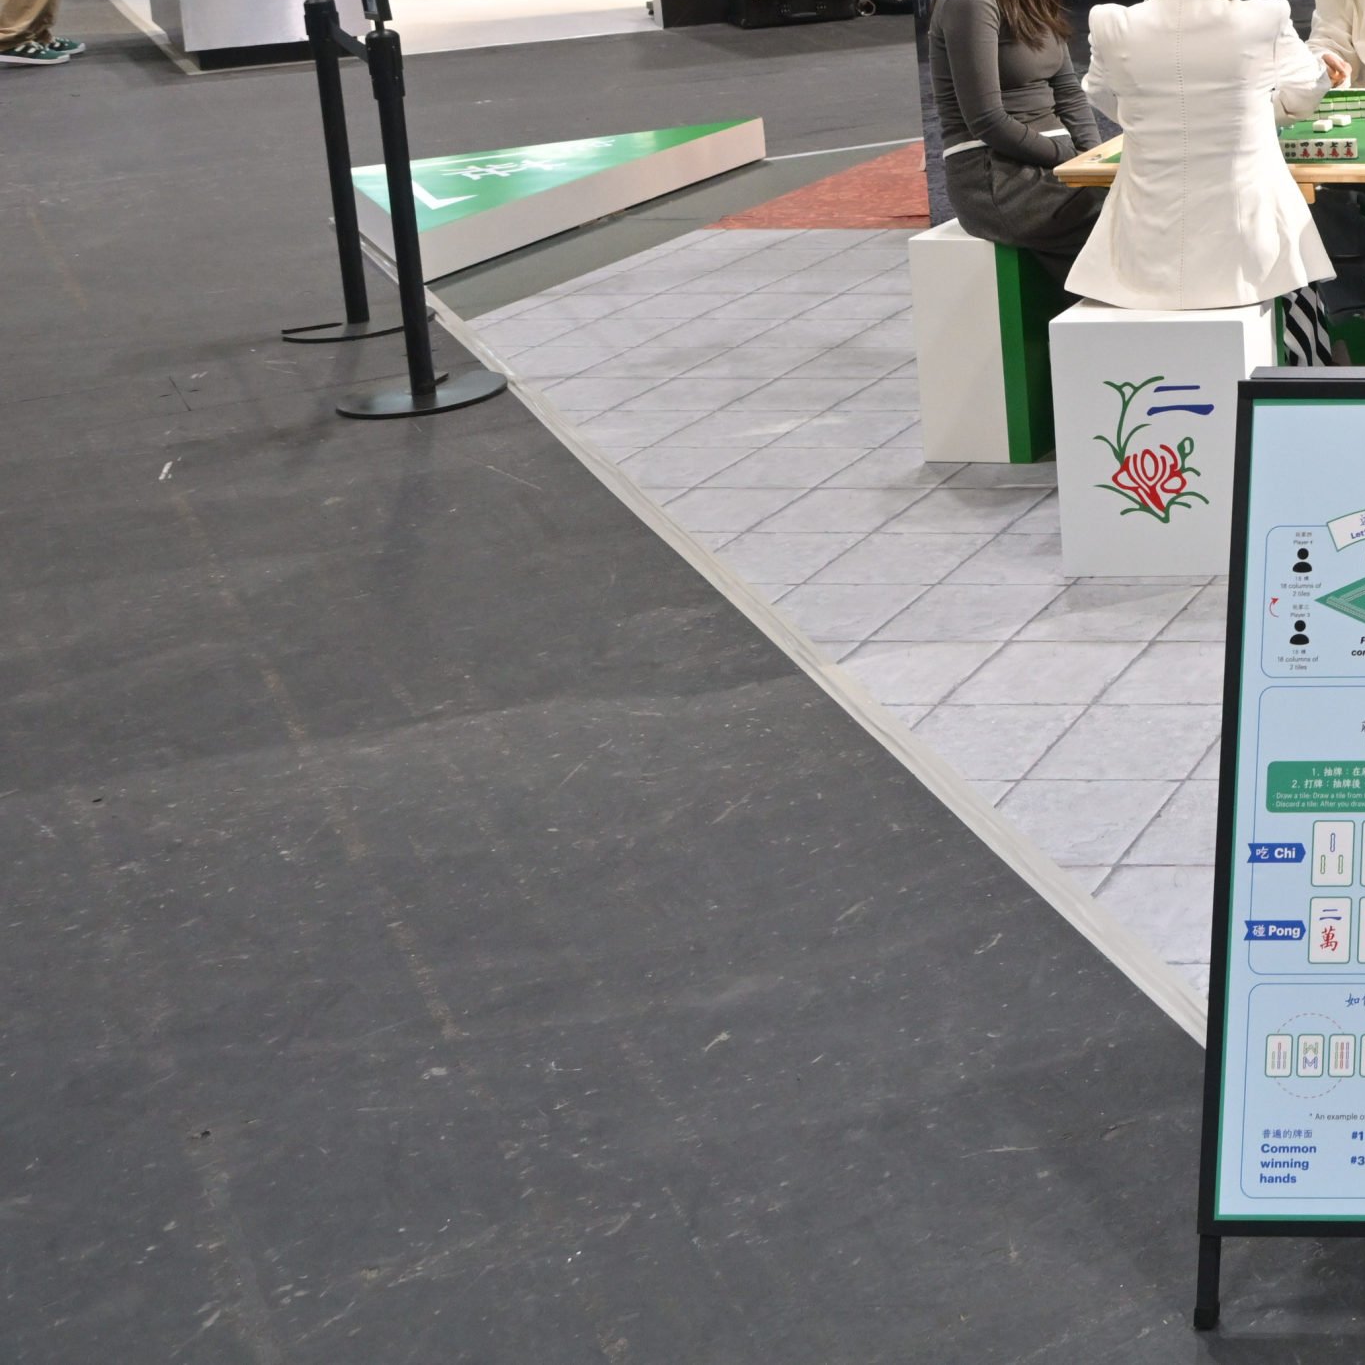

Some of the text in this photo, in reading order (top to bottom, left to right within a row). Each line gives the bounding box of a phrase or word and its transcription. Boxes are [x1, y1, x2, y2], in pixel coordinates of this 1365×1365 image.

[1255, 847, 1296, 860] 吃 Chi
[1252, 925, 1301, 938] 碰 Pong
[1319, 908, 1342, 952] 二萬
[1351, 1131, 1364, 1141] #1
[1261, 1144, 1316, 1153] Common
[1261, 1159, 1309, 1170] winning
[1350, 1156, 1365, 1166] #3
[1260, 1173, 1296, 1183] hands
